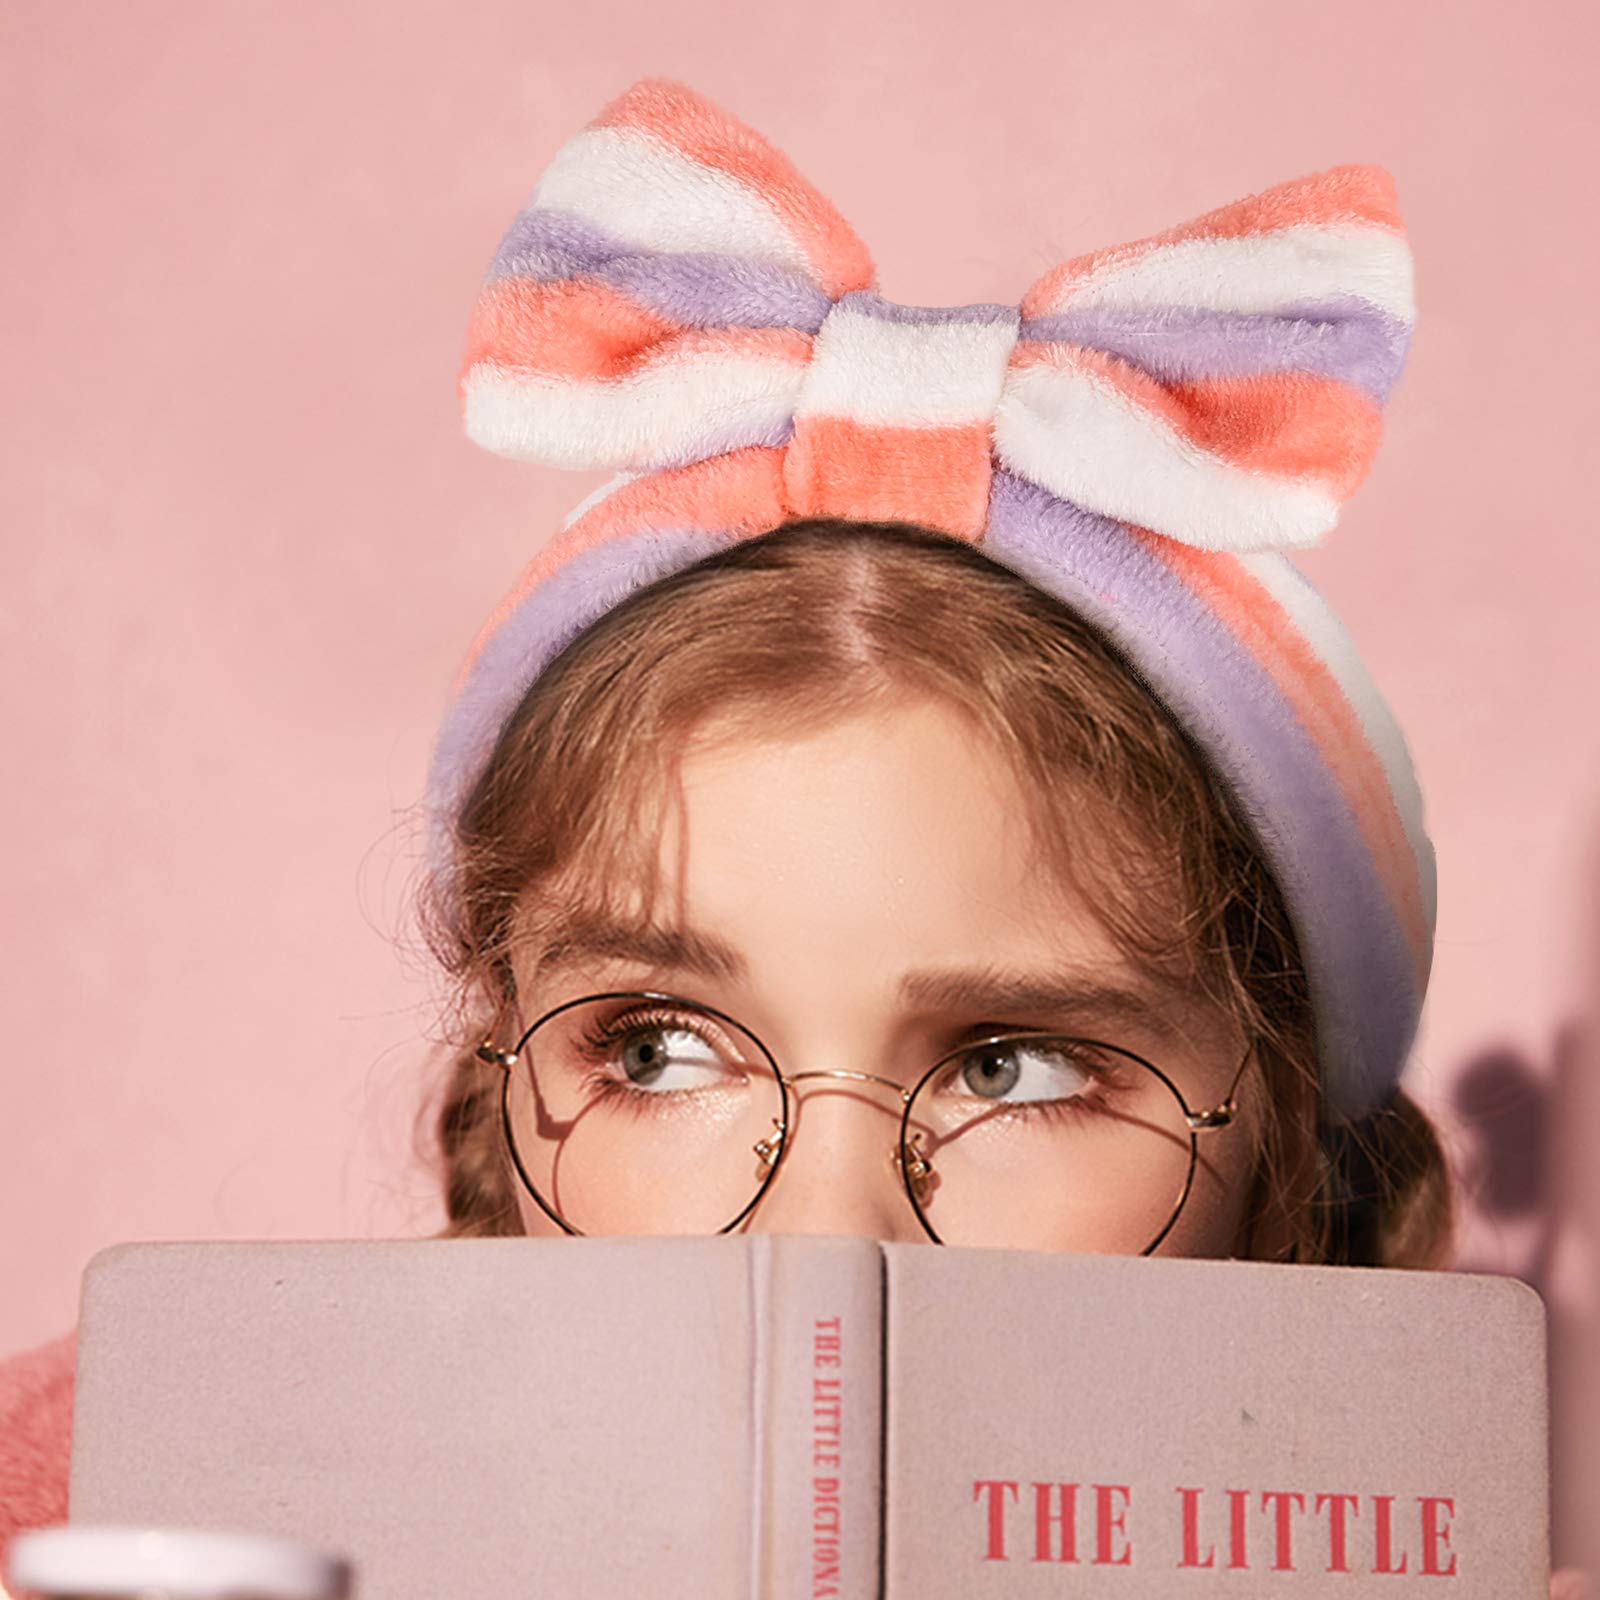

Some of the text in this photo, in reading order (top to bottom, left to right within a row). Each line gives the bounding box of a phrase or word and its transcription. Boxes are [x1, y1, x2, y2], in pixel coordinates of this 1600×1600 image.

[813, 1316, 842, 1368] THE
[812, 1378, 842, 1467] LITTLE
[972, 1479, 1458, 1578] THE LITTLE
